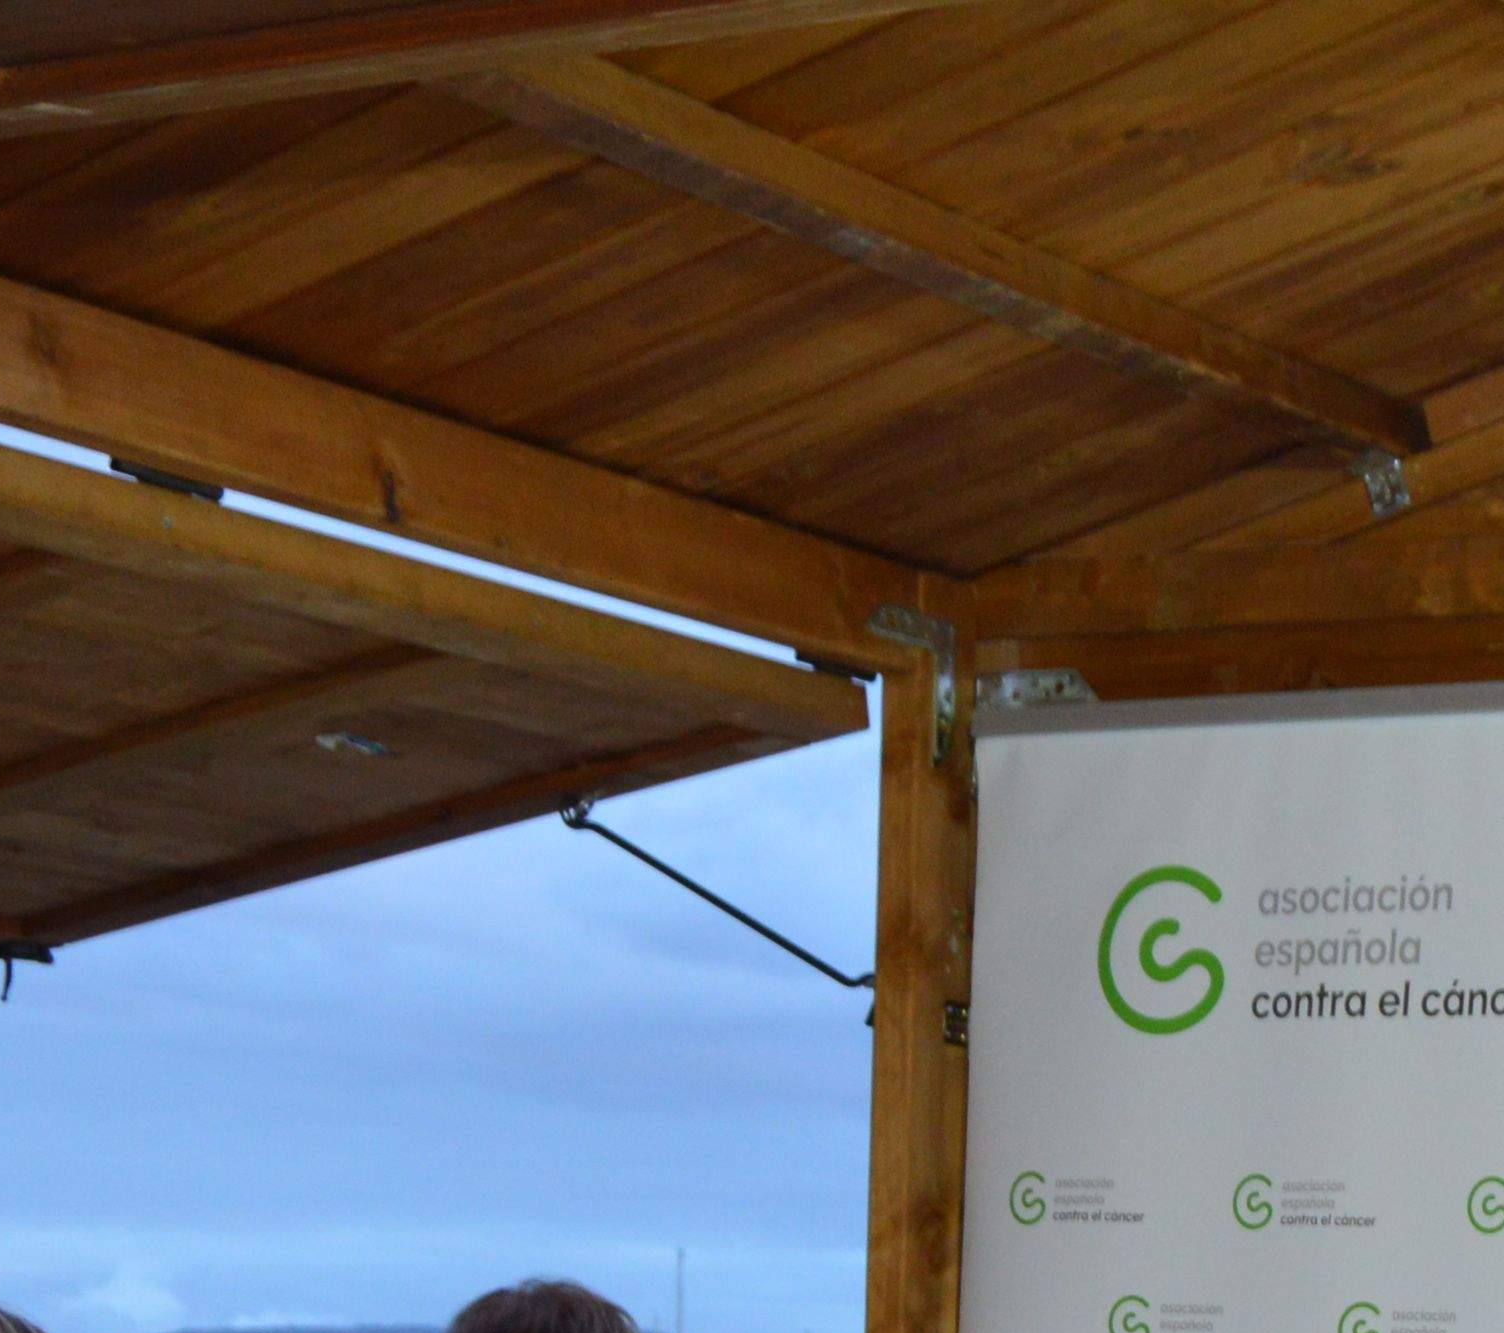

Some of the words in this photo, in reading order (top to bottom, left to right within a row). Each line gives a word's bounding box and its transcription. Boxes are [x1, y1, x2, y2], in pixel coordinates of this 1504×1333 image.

[1257, 875, 1453, 915] asociación
[1254, 927, 1422, 976] española
[1251, 982, 1367, 1018] contra
[1378, 980, 1411, 1016] el
[1053, 1211, 1089, 1222] contra
[1091, 1210, 1102, 1221] el
[1104, 1210, 1145, 1223] cáncer
[1280, 1214, 1318, 1225] contra
[1320, 1214, 1332, 1225] el
[1334, 1214, 1376, 1227] cáncer
